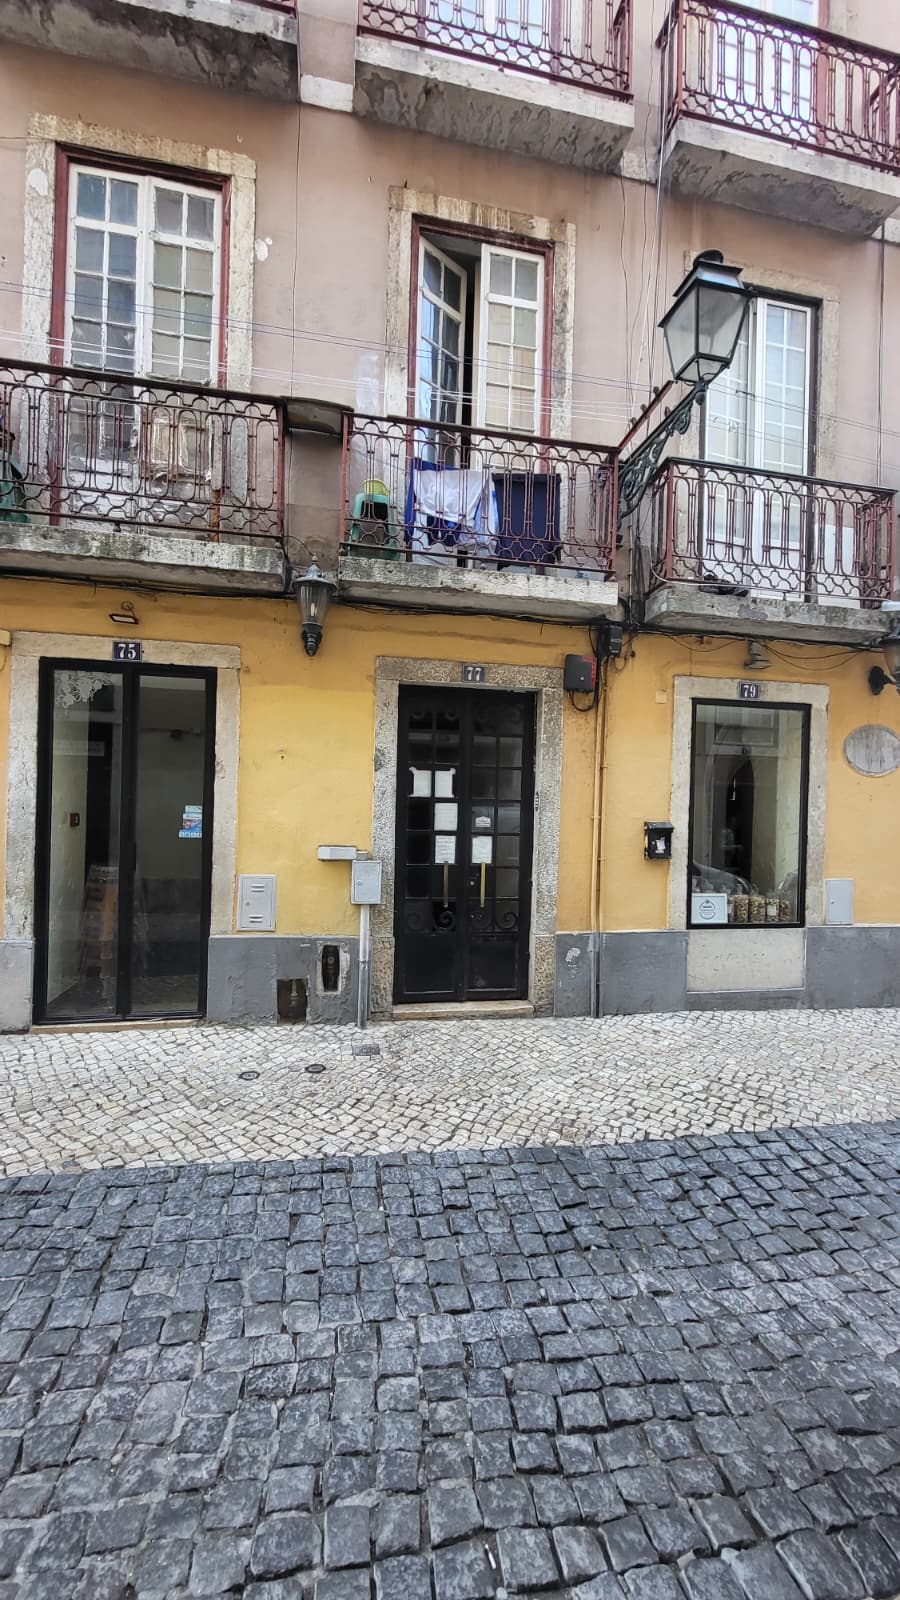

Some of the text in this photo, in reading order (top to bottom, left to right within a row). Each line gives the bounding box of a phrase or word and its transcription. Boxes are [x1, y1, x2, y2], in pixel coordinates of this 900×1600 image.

[118, 643, 137, 659] 75
[467, 667, 481, 681] 77
[744, 685, 756, 698] 79
